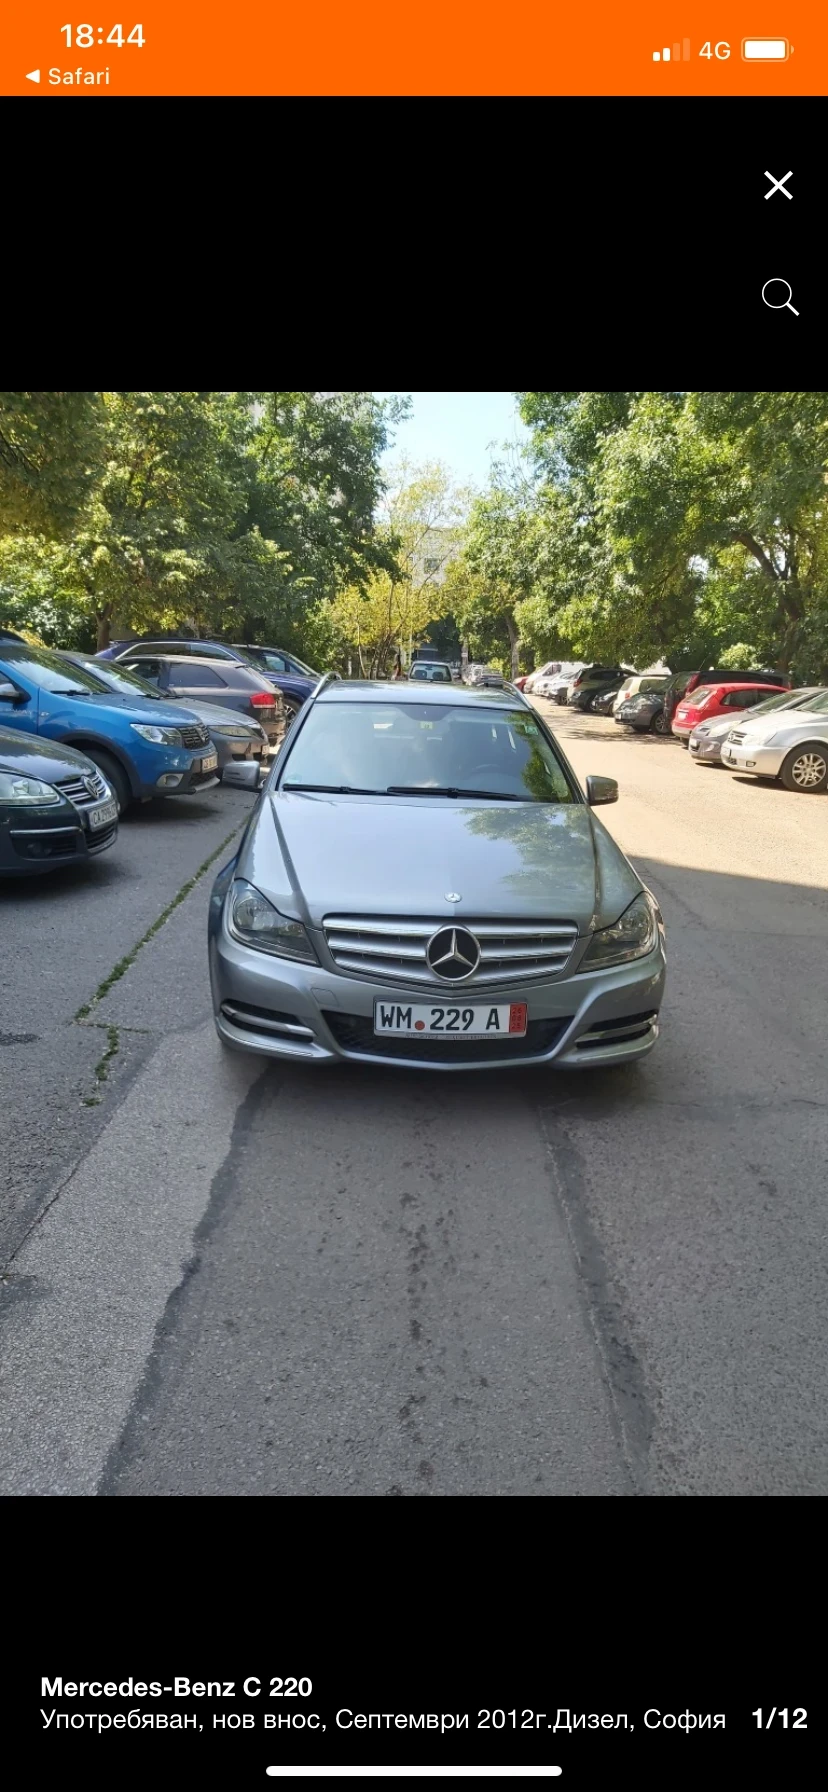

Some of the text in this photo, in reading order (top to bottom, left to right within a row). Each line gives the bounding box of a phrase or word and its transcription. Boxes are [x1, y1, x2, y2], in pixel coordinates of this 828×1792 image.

[380, 1005, 500, 1031] WM 229 A
